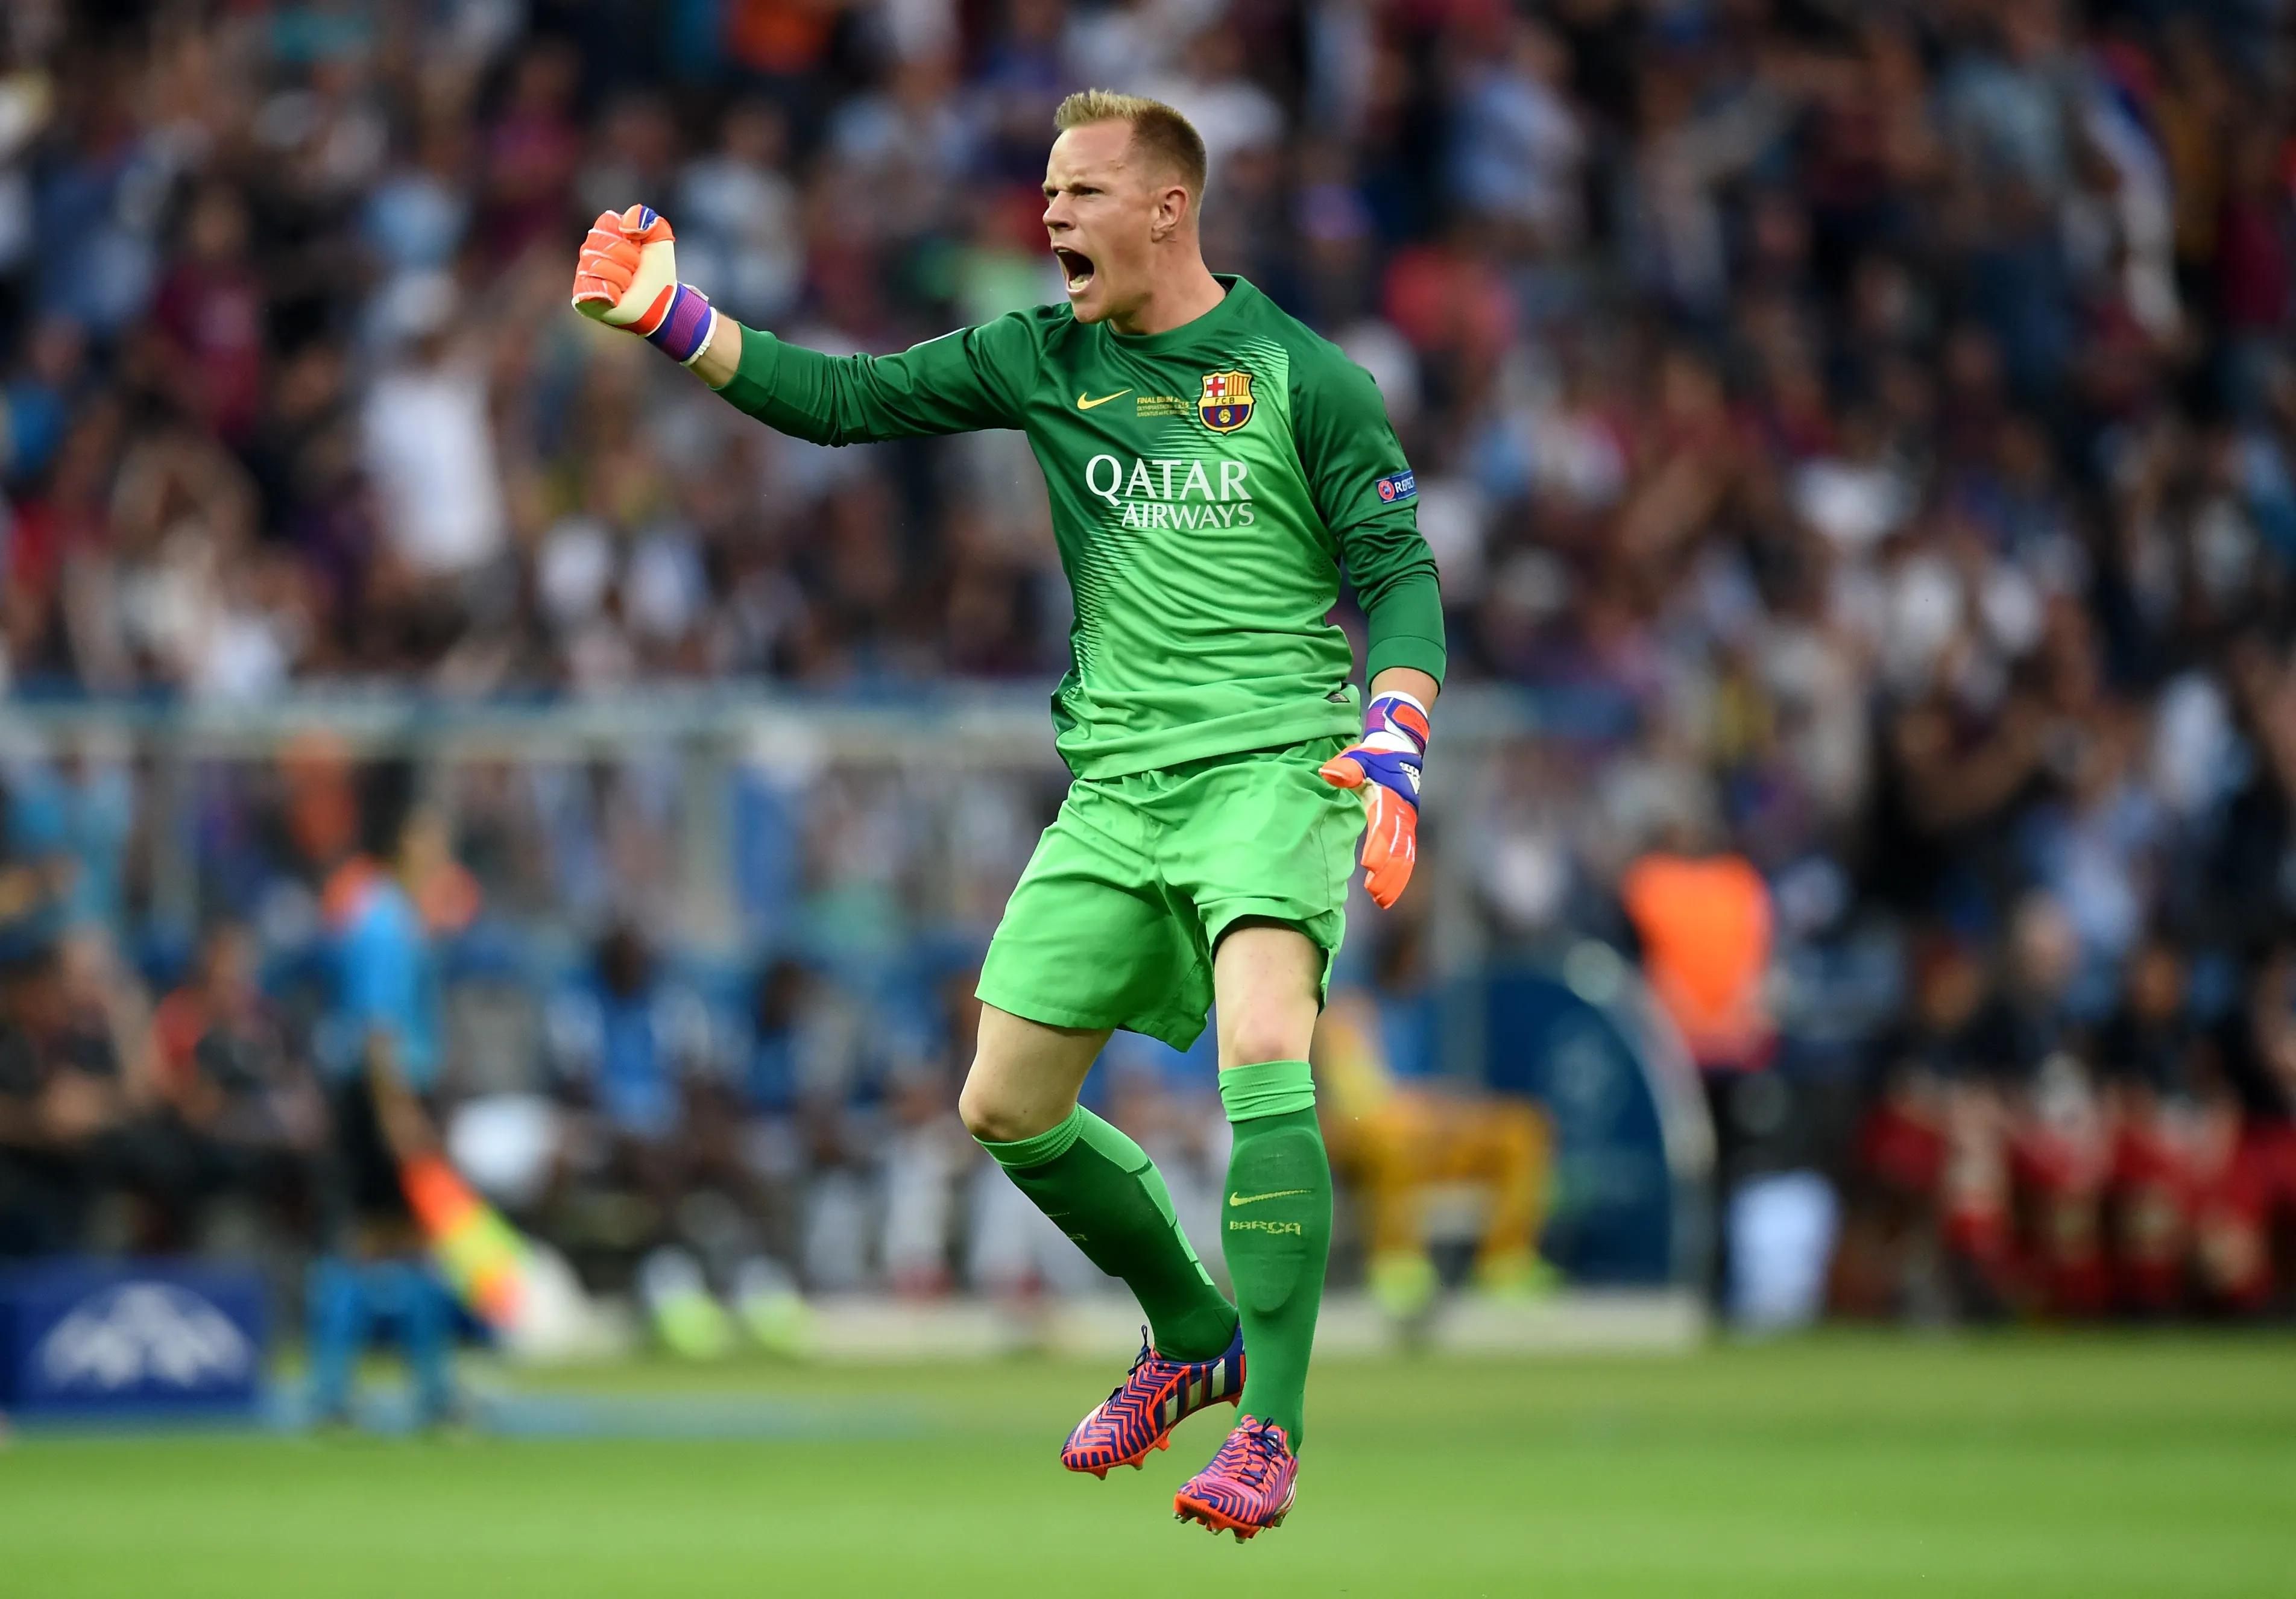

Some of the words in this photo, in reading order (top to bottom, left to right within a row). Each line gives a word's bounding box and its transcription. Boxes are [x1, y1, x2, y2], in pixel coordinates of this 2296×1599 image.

[1086, 455, 1252, 506] QATAR
[1121, 502, 1254, 529] AIRWAYS
[1229, 1221, 1301, 1235] BARÇA
